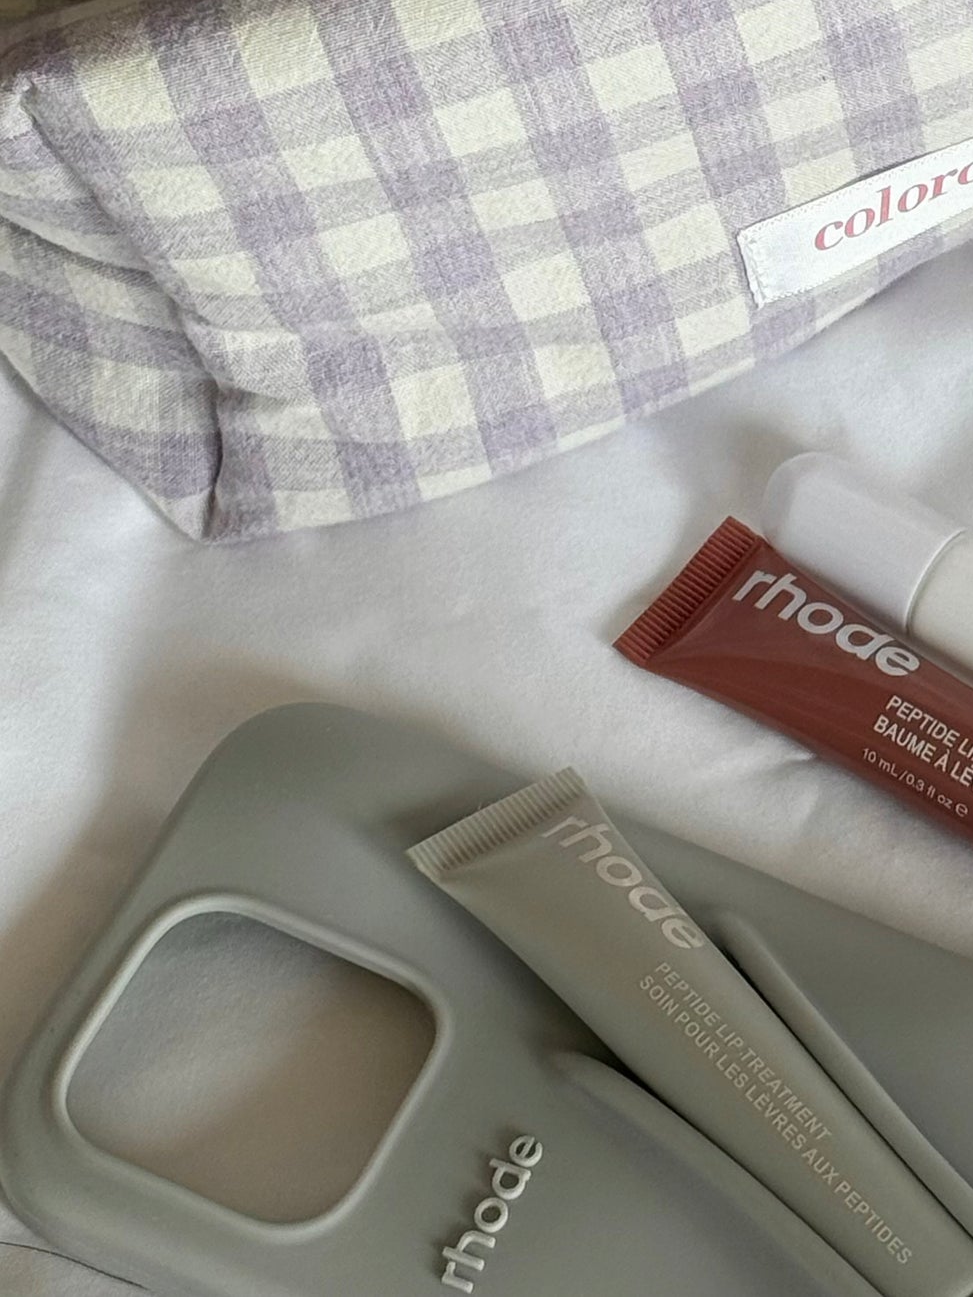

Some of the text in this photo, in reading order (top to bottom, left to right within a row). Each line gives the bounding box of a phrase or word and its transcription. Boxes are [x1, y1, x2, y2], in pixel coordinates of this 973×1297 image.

[731, 569, 920, 677] rhode
[862, 748, 878, 765] 10
[926, 785, 936, 800] fl
[937, 794, 953, 809] oz
[873, 714, 936, 763] BAUME
[934, 750, 951, 773] À
[885, 695, 960, 747] PEPTIDE
[541, 815, 704, 951] rhode
[655, 962, 832, 1141] PEPTIDE LIP TREATMENT
[639, 975, 913, 1264] SOIN POUR LES LÈVRES AUX PEPTIDES
[440, 1133, 544, 1294] rhode
